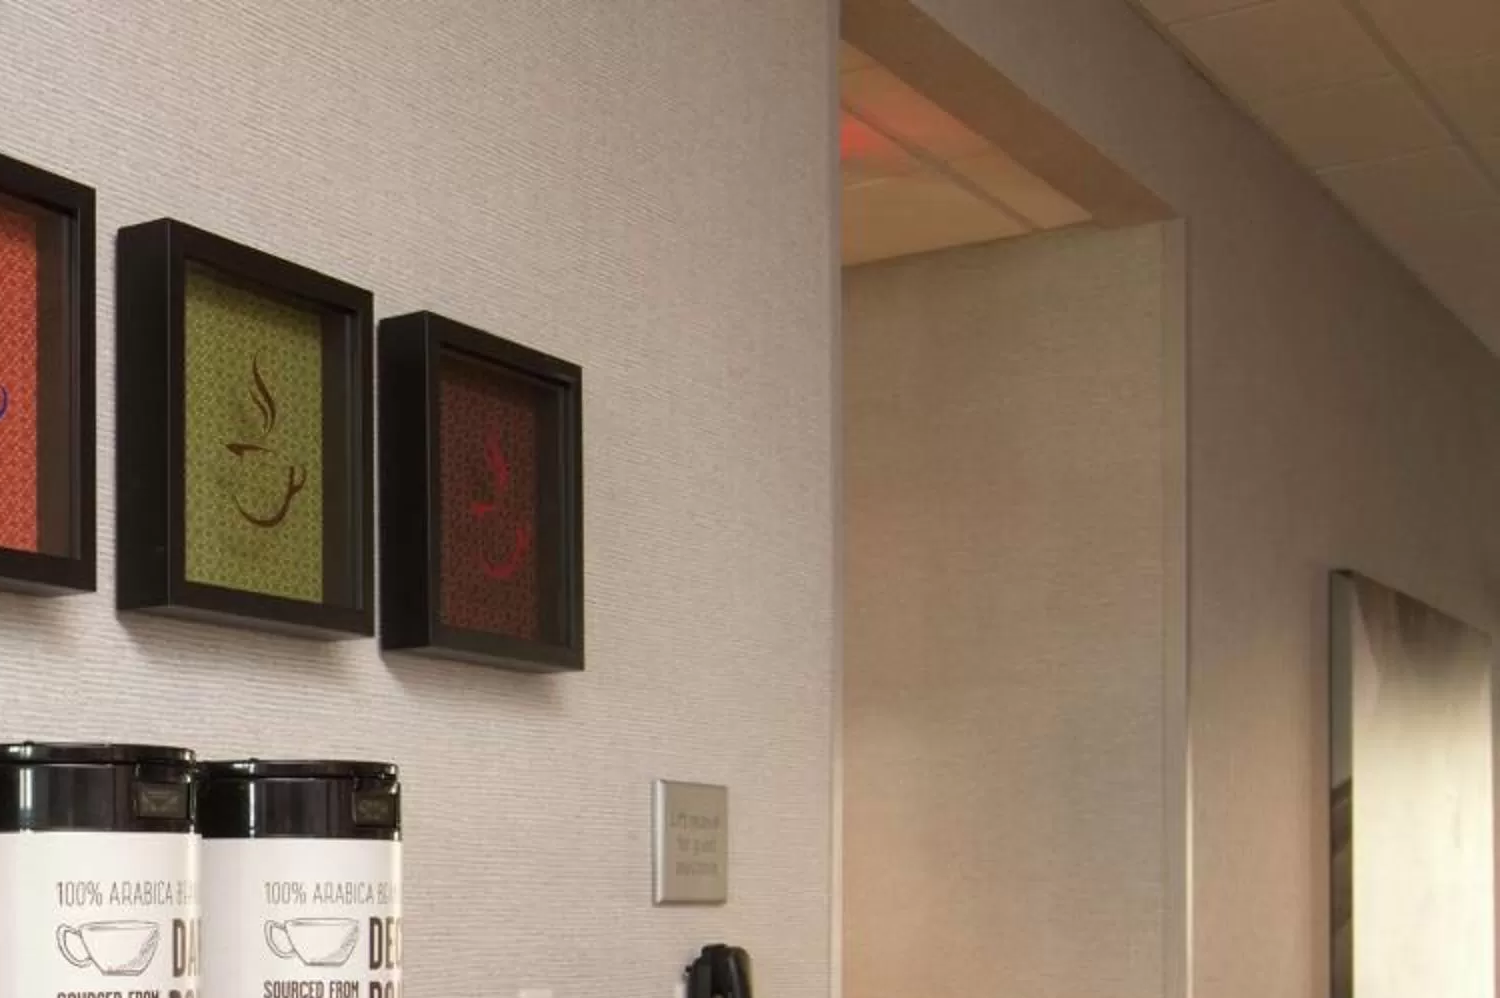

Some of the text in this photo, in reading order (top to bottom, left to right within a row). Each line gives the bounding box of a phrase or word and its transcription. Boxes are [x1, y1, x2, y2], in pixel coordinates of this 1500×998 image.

[56, 880, 103, 907] 100%
[110, 880, 173, 906] ARABICA
[263, 881, 307, 905] 100%
[312, 881, 375, 905] ARABICA
